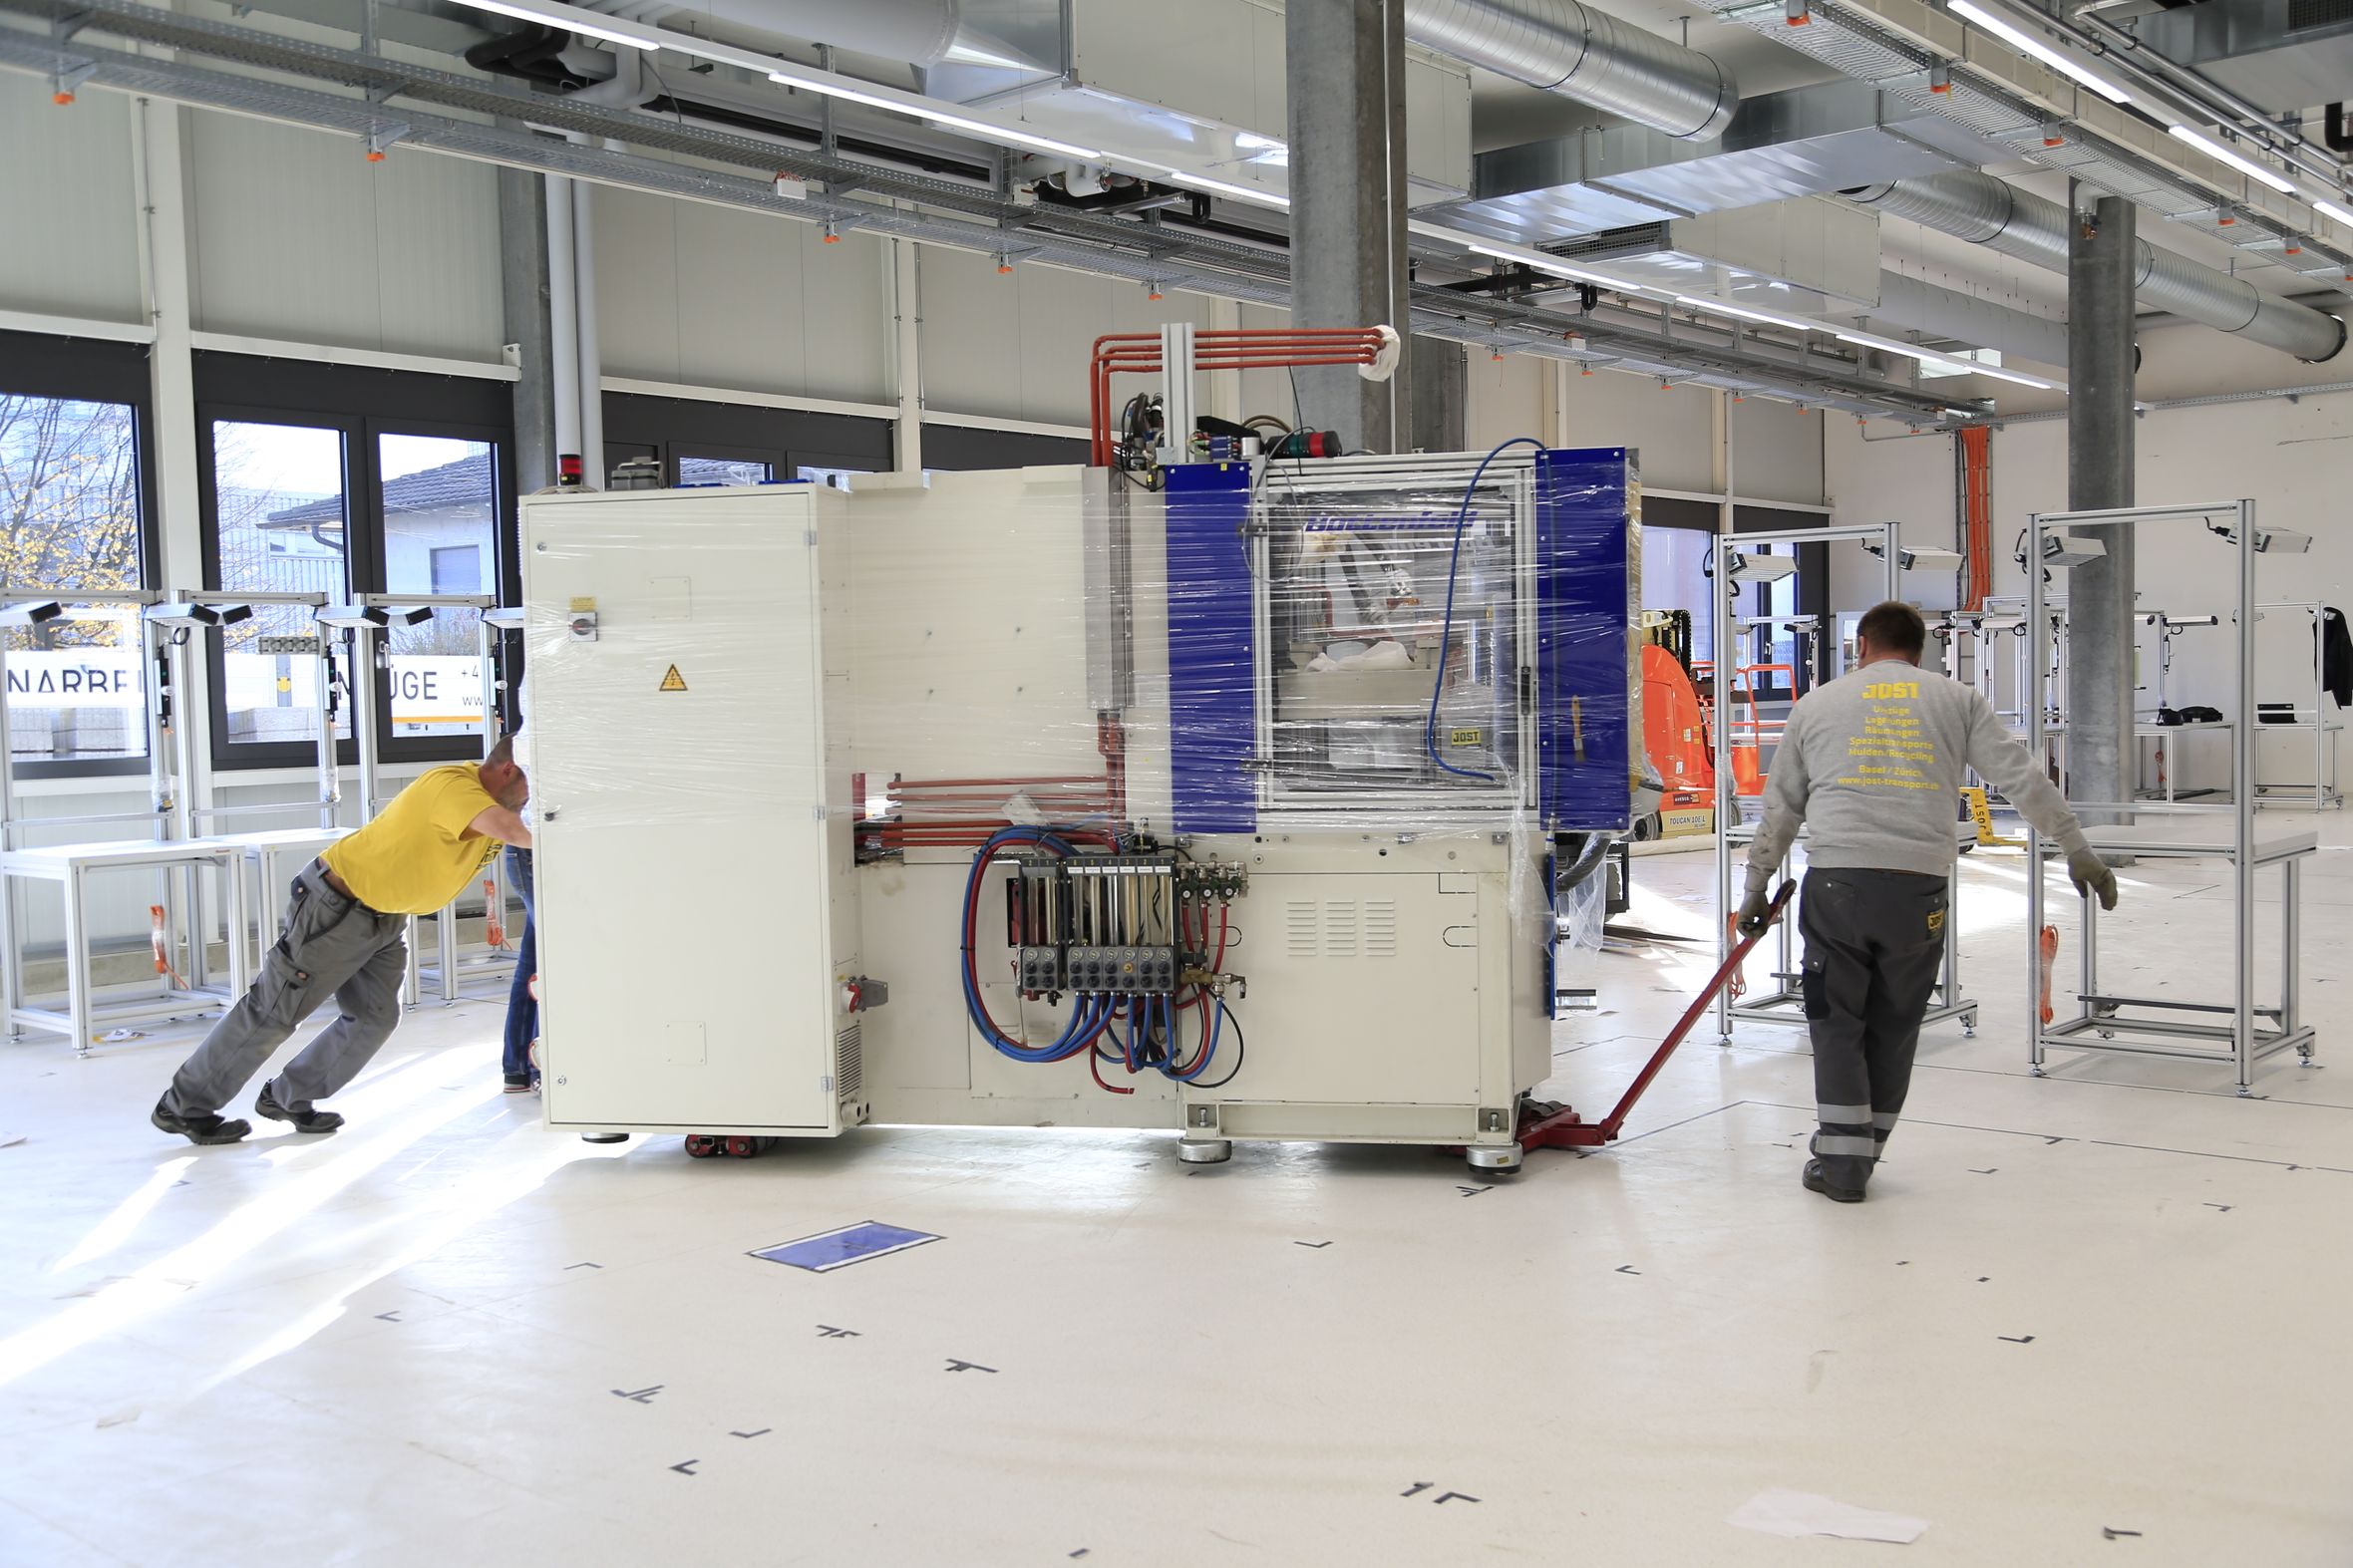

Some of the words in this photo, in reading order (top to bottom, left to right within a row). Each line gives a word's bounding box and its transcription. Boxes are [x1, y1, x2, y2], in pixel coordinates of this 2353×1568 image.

[1861, 682, 1920, 700] JOST
[1864, 716, 1920, 728] Lagerungen
[1453, 731, 1479, 743] JOST
[1864, 726, 1920, 739] Räumungen
[1858, 765, 1885, 775] Basel
[1669, 816, 1691, 825] TOUCAN
[1974, 804, 1987, 829] JOST
